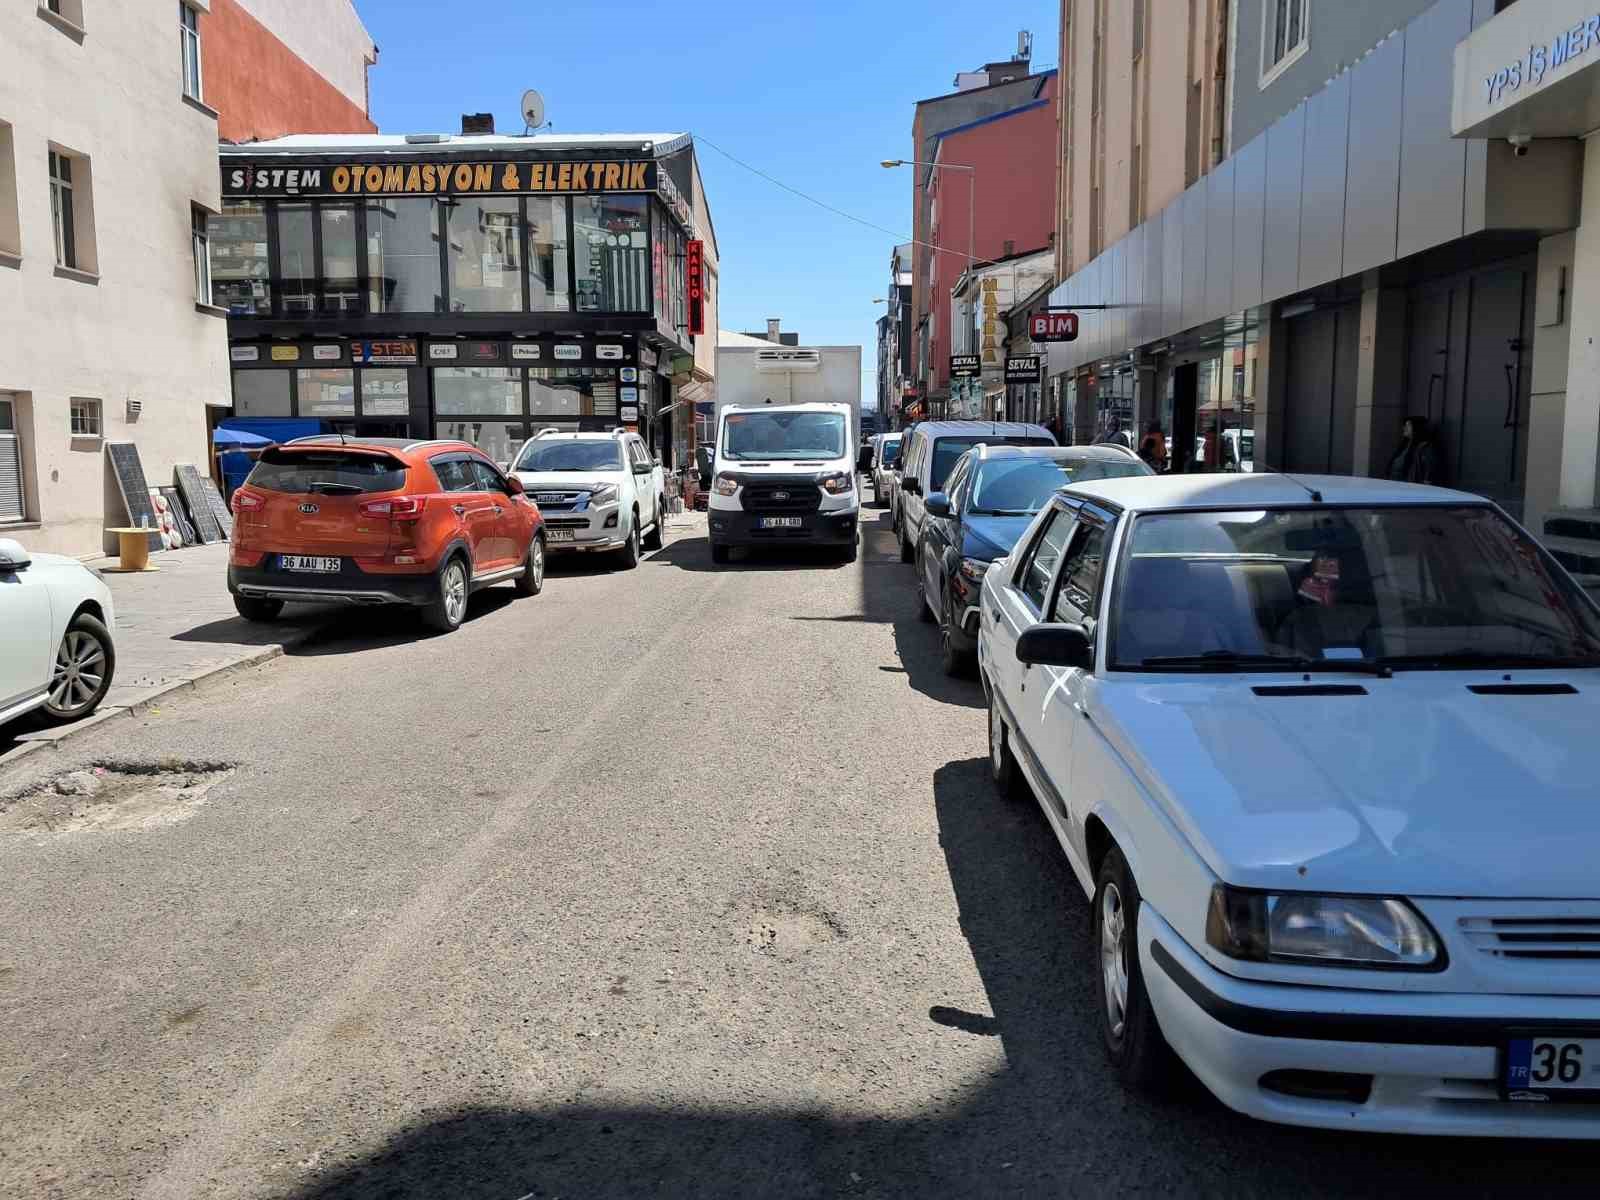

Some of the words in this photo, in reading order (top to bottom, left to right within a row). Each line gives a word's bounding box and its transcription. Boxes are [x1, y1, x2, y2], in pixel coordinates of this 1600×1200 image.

[332, 164, 493, 193] OTOMASYON
[502, 163, 520, 190] &
[691, 243, 700, 298] KABLO
[1035, 315, 1073, 334] BİM
[301, 504, 317, 513] KIA
[283, 556, 296, 568] 36
[299, 557, 318, 569] AAU
[323, 559, 340, 570] 135
[1511, 1066, 1529, 1078] TR
[1532, 1043, 1583, 1082] 36
